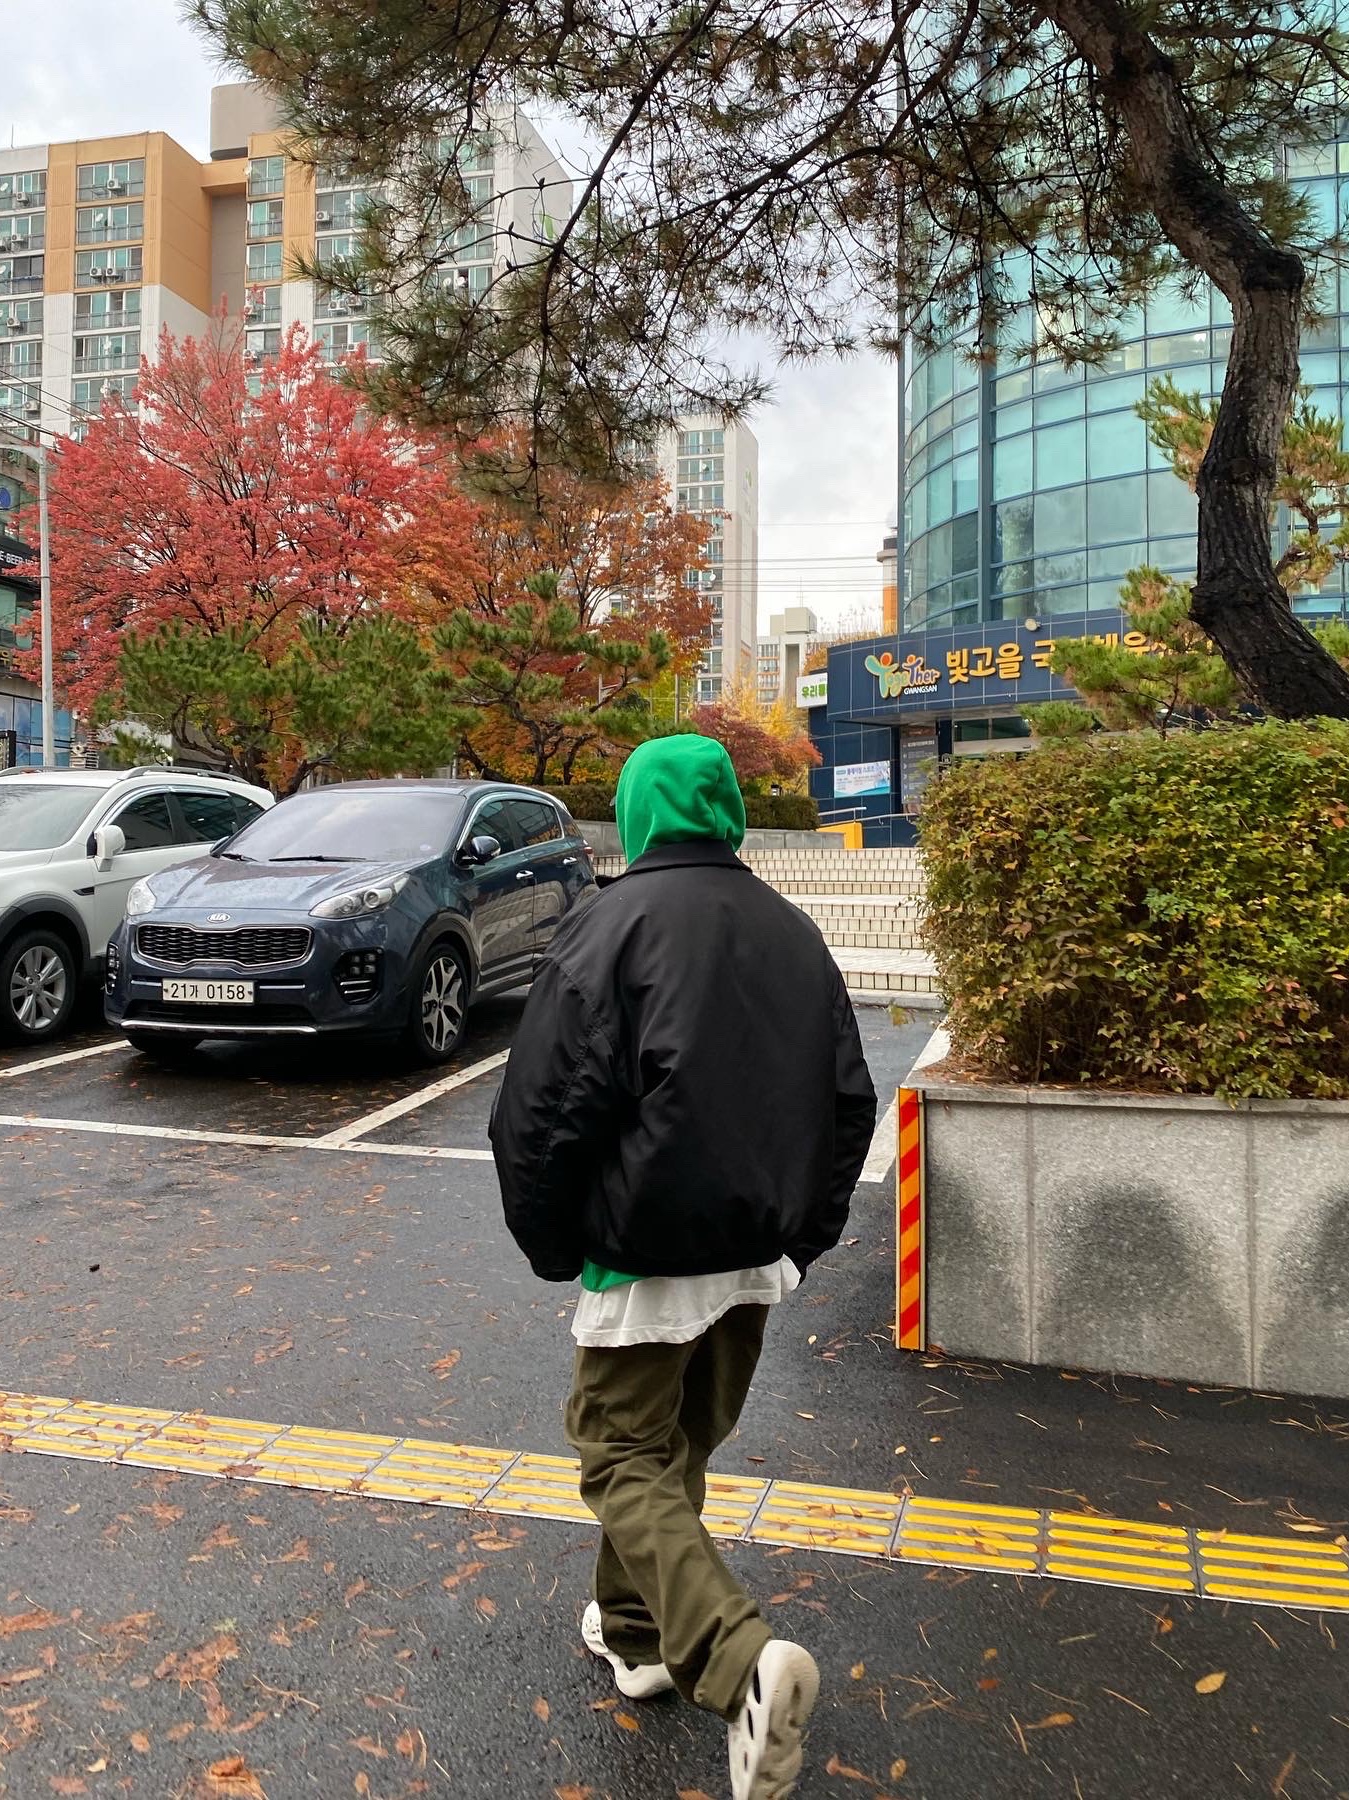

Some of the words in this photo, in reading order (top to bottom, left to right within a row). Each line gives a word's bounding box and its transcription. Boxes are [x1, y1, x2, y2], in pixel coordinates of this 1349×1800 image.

[945, 641, 1025, 684] 빛고을
[903, 684, 938, 695] GWANGSAN
[171, 983, 198, 999] 21가
[207, 984, 245, 1000] 0158
